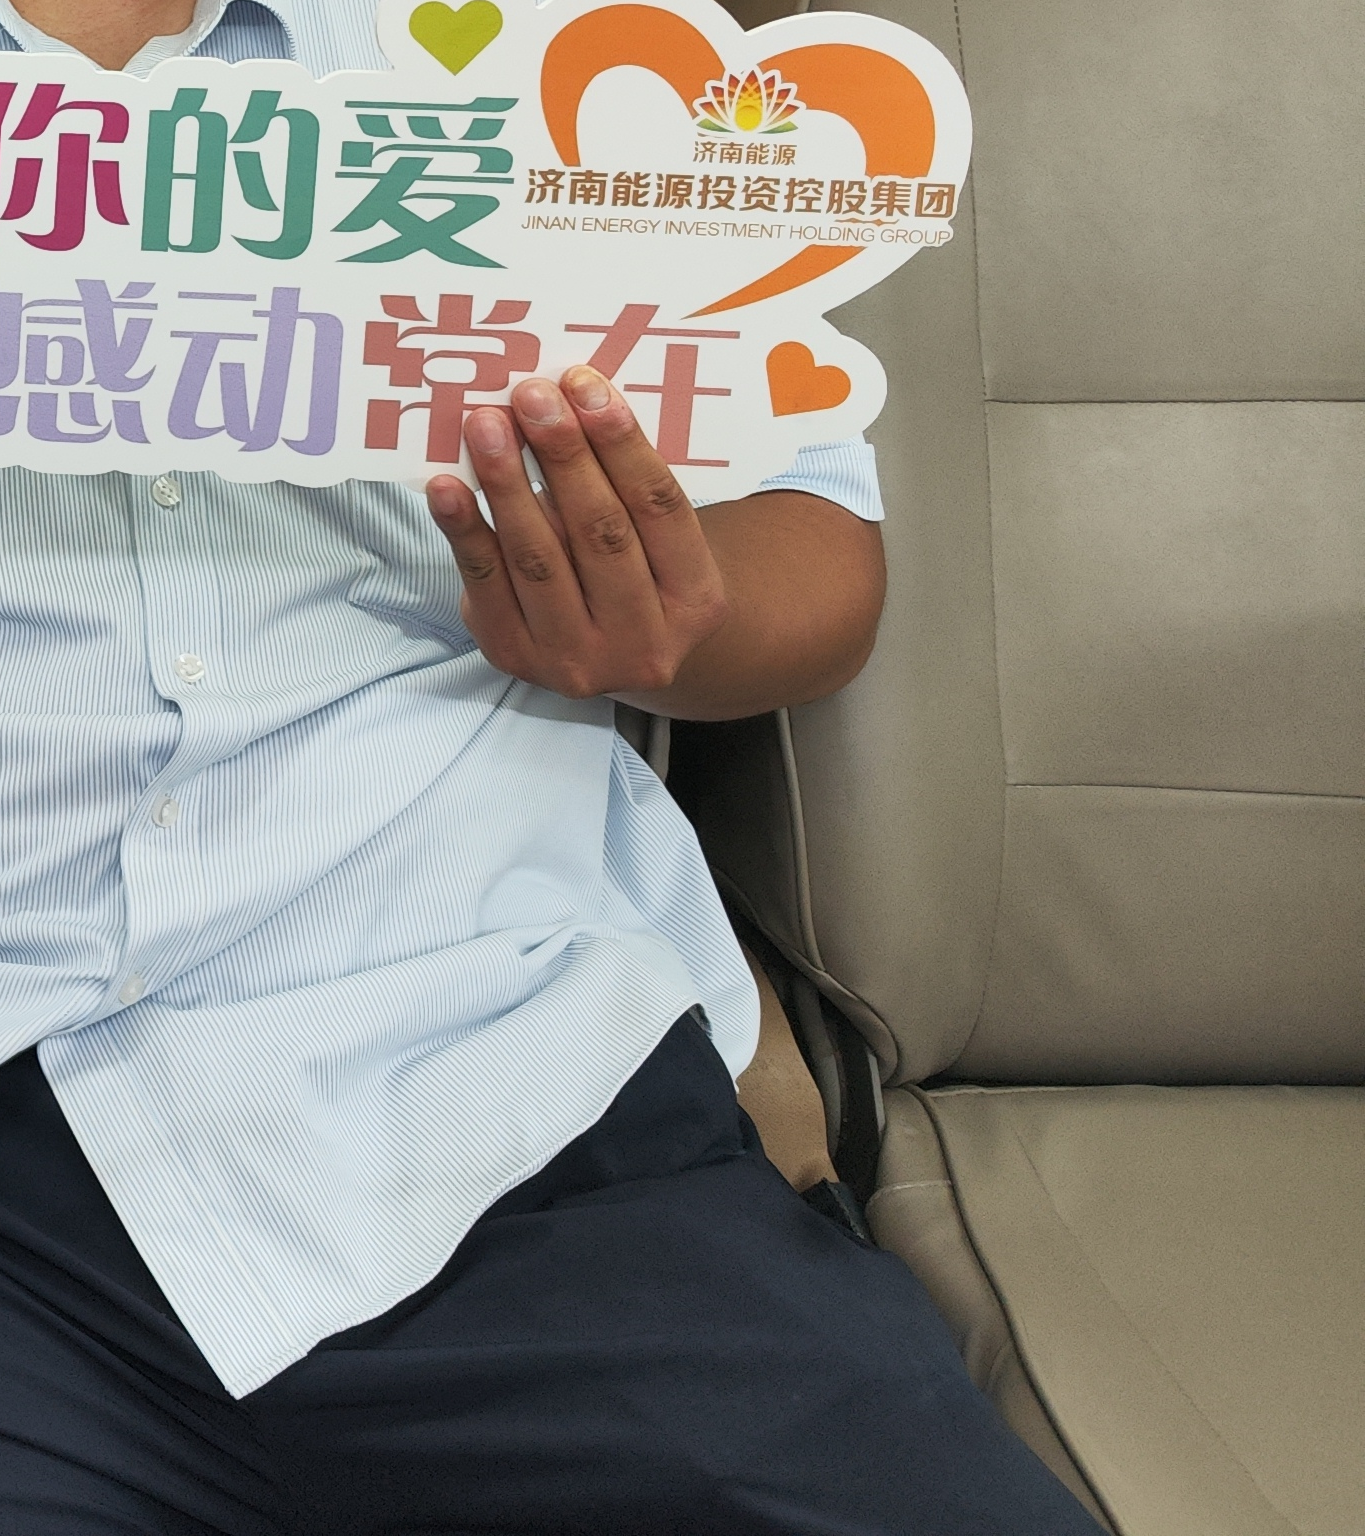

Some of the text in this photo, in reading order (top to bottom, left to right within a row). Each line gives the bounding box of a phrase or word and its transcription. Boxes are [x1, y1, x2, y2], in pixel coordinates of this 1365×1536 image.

[692, 140, 798, 166] 济南能源
[523, 168, 957, 220] 济南能源投资控股集团
[521, 215, 953, 245] JINAN ENERGY INVESTMENT HOLDING GROUP
